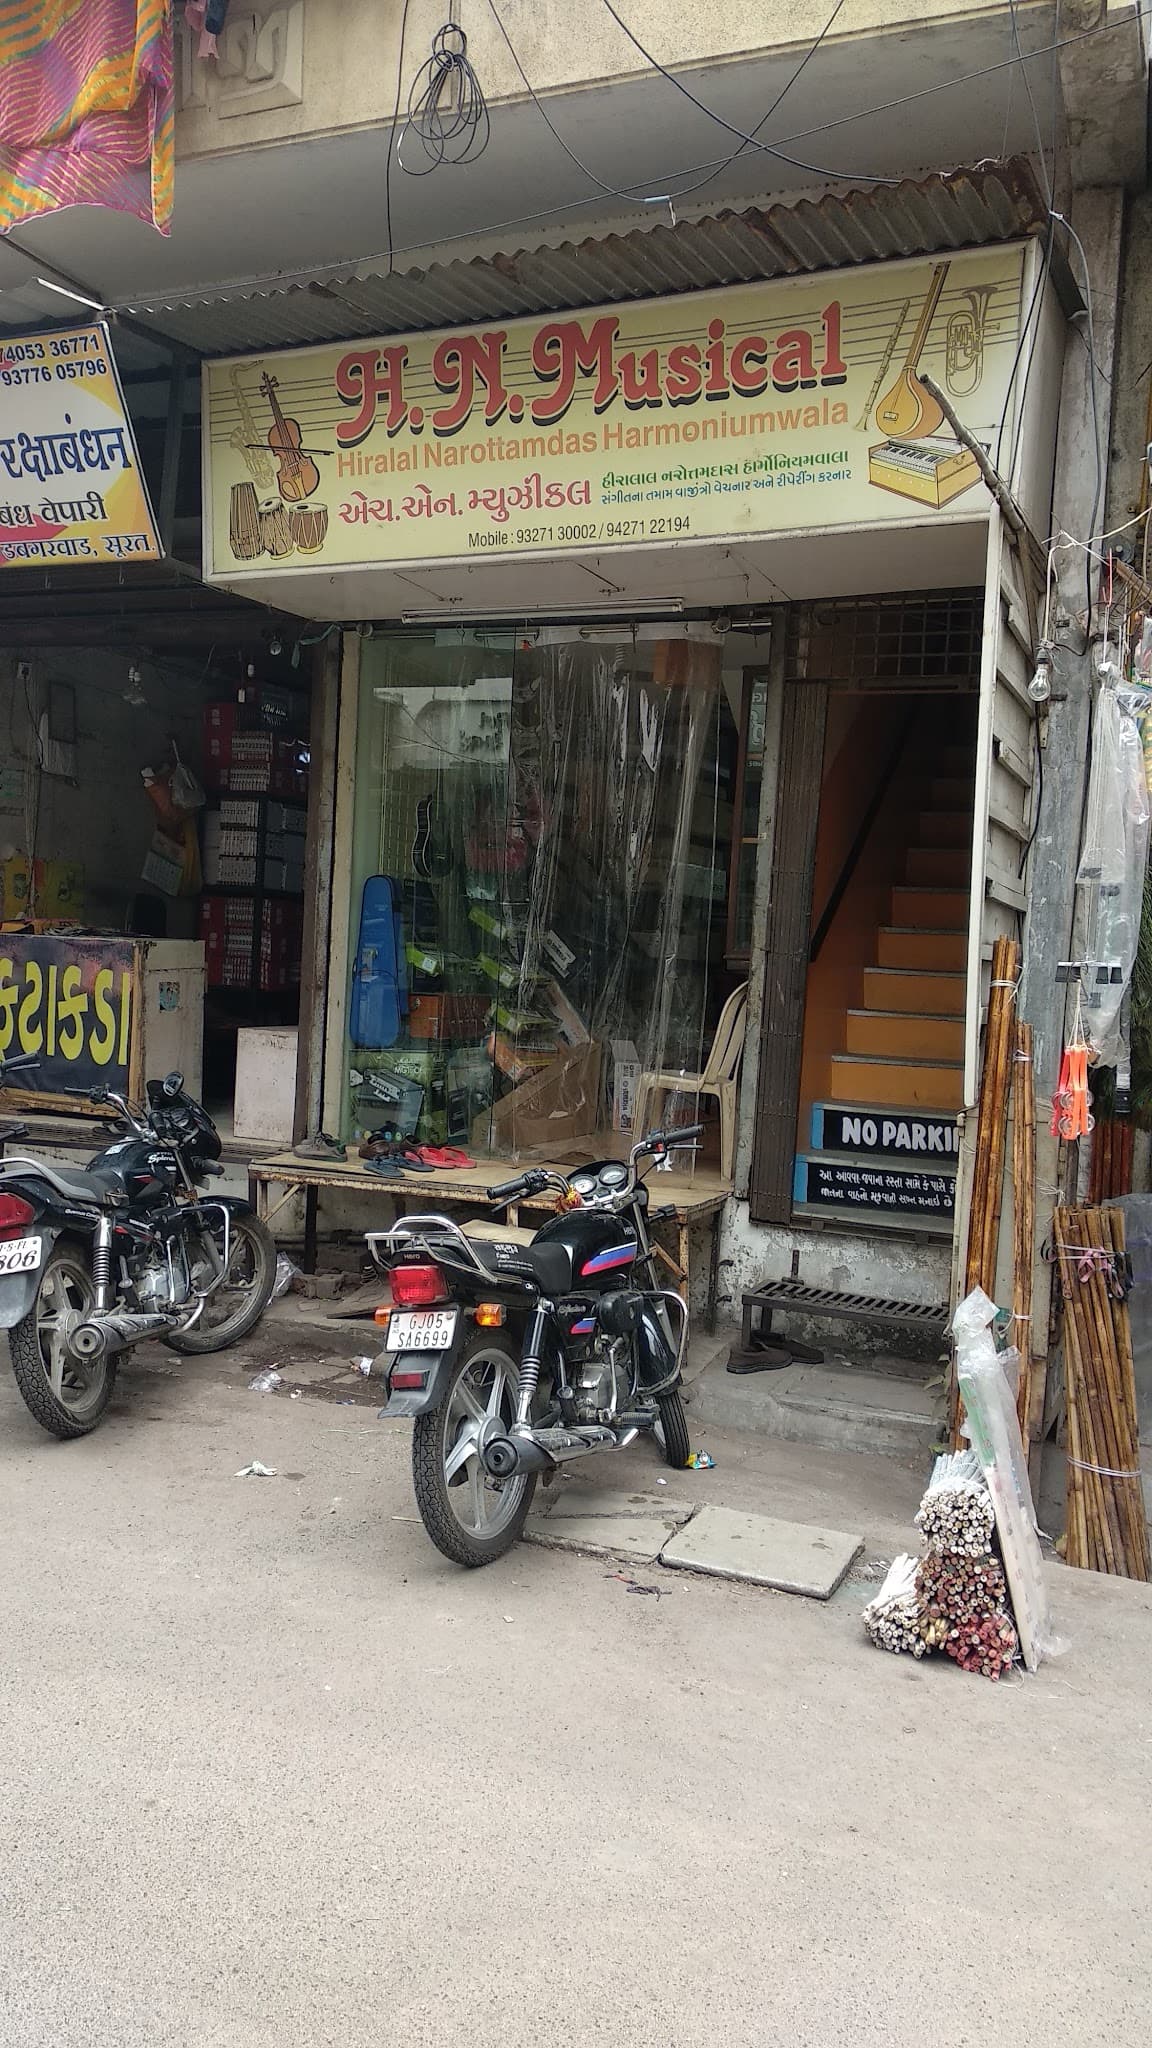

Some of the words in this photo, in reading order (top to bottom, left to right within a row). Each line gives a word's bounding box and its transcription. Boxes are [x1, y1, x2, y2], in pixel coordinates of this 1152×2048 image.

[49, 334, 99, 357] 36771
[1, 366, 52, 386] 93776
[56, 358, 107, 380] 05796
[531, 300, 847, 426] Musical
[0, 413, 132, 482] रक्षाबंधन
[337, 444, 418, 478] Hiralal
[423, 428, 597, 469] Narottamdas
[603, 398, 849, 450] Harmoniumwala
[601, 489, 643, 505] સંગીતના
[646, 488, 673, 501] તમામ
[714, 480, 751, 494] વેચનાર
[753, 474, 774, 489] અને
[818, 469, 852, 484] કરનાર
[602, 471, 657, 489] હીરાલાલ
[38, 491, 108, 523] वेपारी
[516, 527, 553, 544] 93271
[557, 524, 597, 541] 30002
[607, 520, 646, 537] 94271
[649, 516, 690, 534] 22194
[842, 1117, 877, 1146] NO
[409, 1313, 443, 1330] GJ05
[398, 1330, 448, 1348] SA6699
